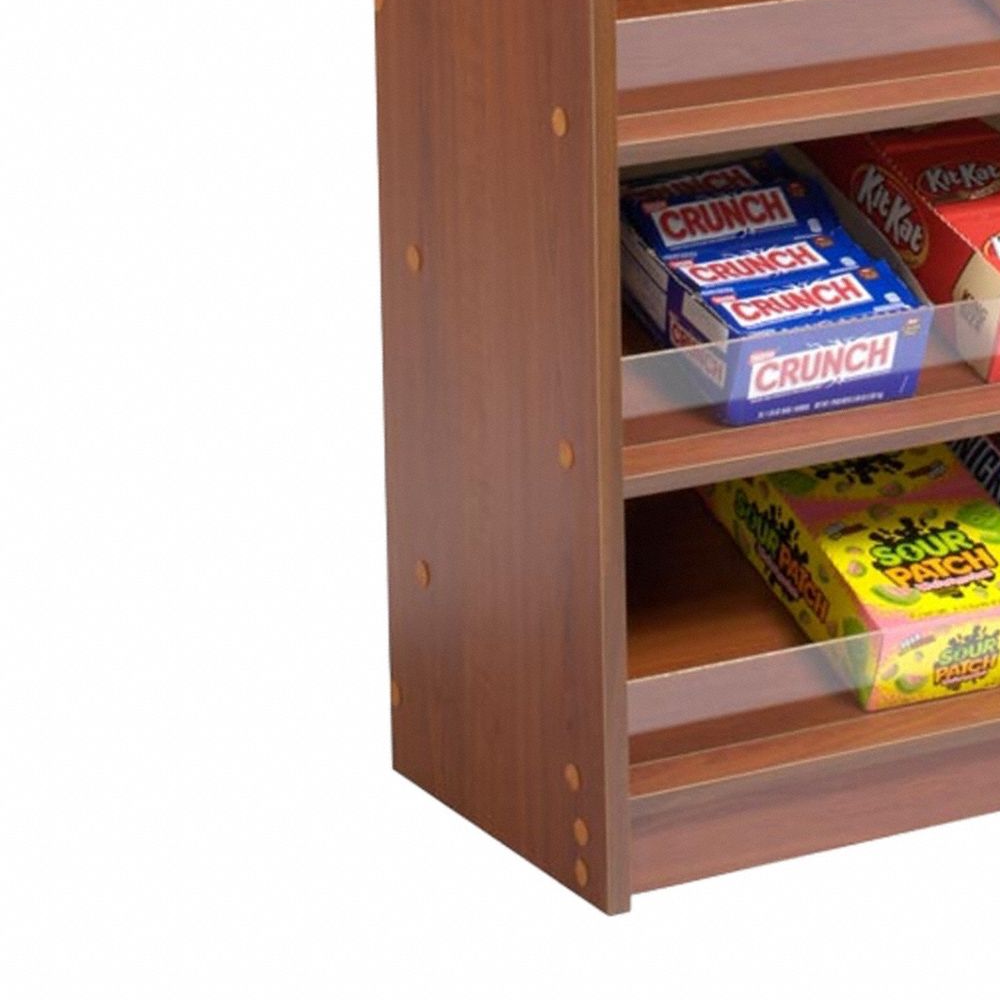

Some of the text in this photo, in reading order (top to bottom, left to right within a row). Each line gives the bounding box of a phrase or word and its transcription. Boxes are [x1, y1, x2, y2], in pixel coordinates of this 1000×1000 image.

[658, 190, 789, 240] CRUNCH
[691, 245, 819, 283] CRUNCH
[731, 278, 863, 322] CRUNCH
[754, 337, 892, 393] CRUNCH
[871, 531, 974, 568] SOUR
[883, 547, 994, 589] PATCH
[938, 636, 999, 662] SOUR
[934, 655, 998, 685] PATCH
